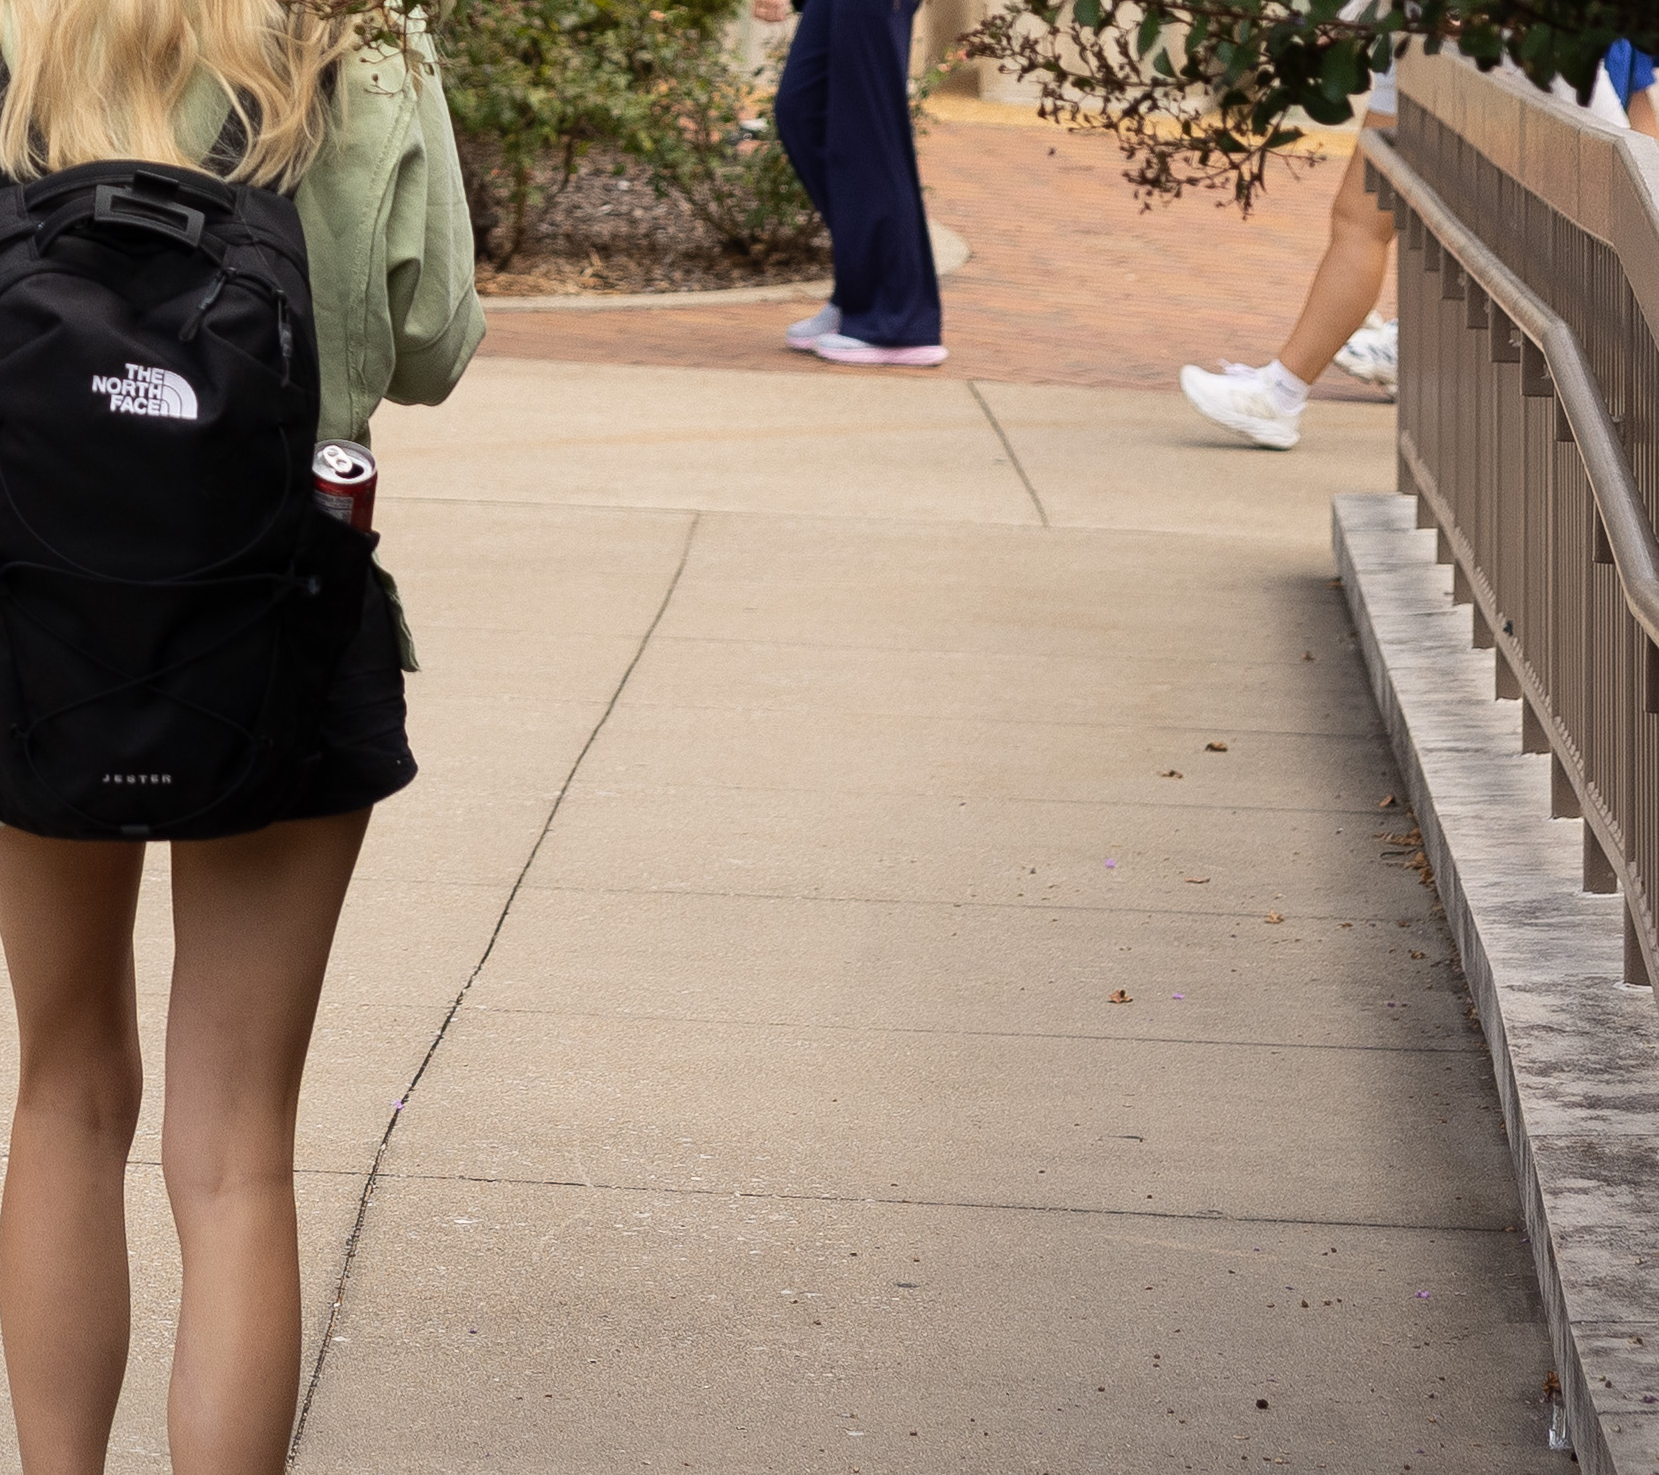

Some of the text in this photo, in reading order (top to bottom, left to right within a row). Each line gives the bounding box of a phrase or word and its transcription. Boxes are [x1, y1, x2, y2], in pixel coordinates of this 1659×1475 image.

[125, 363, 164, 385] THE
[92, 375, 163, 399] NORTH
[110, 394, 160, 416] FACE
[102, 774, 172, 784] JESTER
